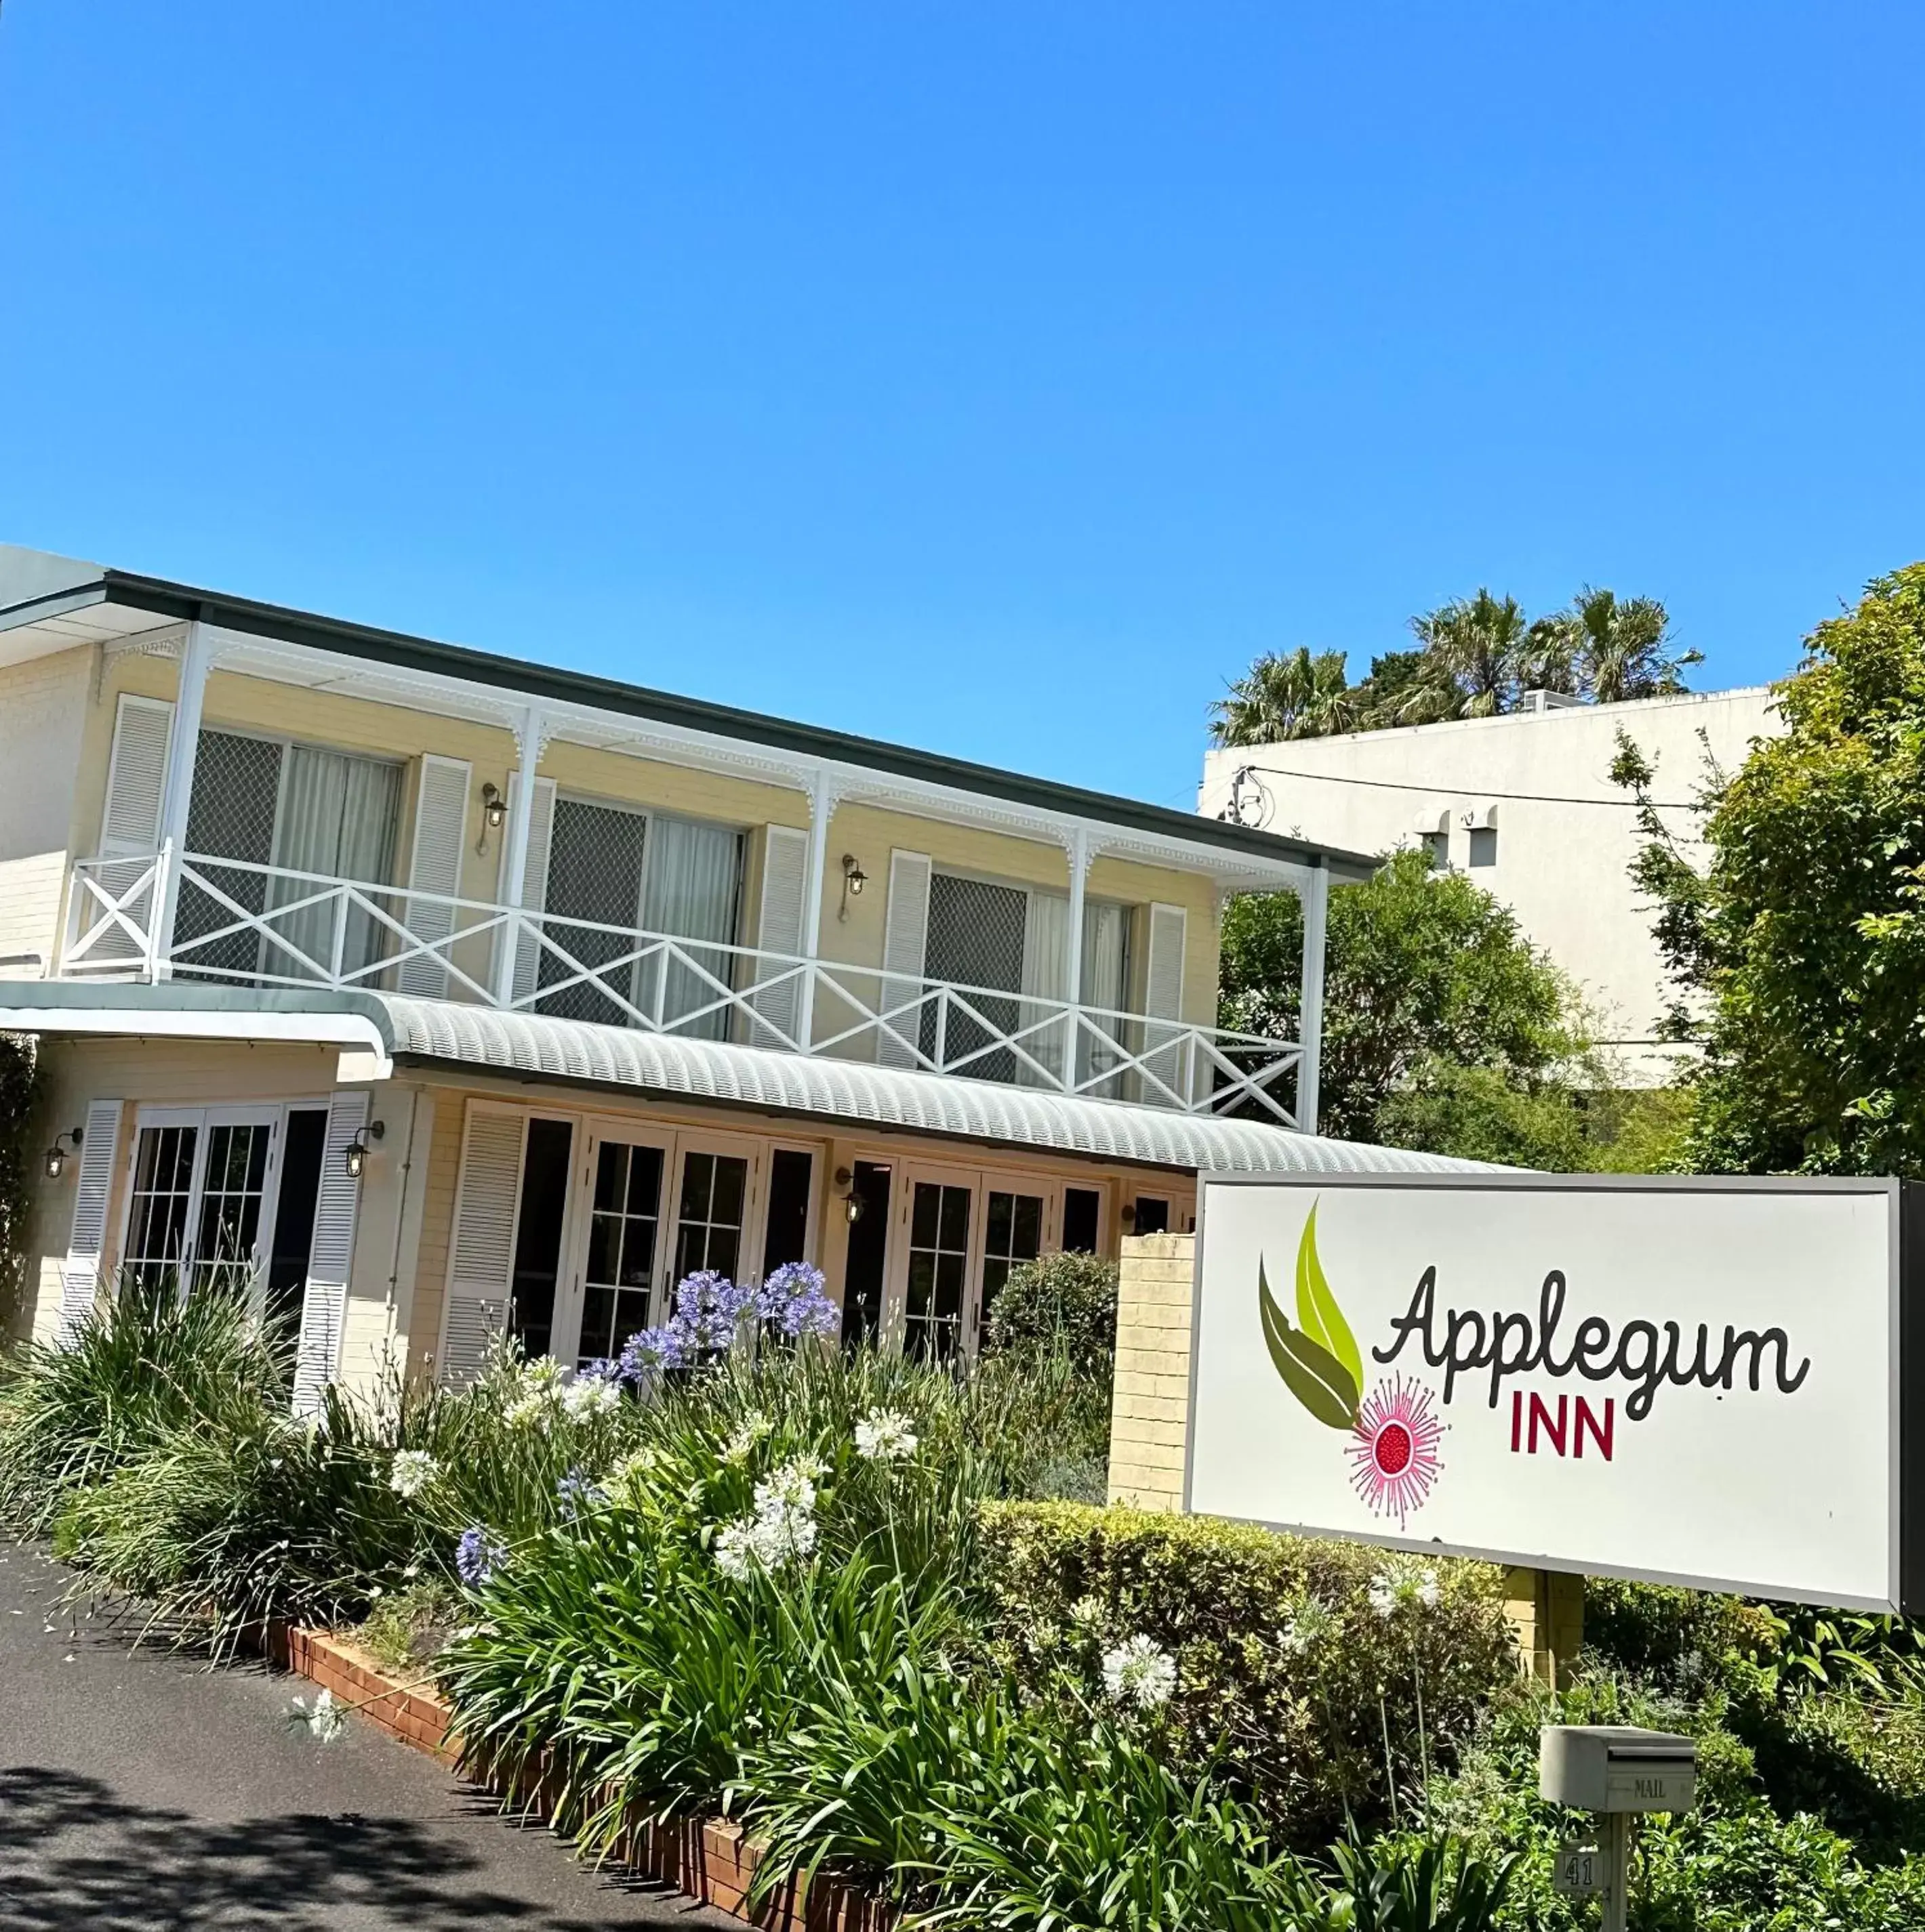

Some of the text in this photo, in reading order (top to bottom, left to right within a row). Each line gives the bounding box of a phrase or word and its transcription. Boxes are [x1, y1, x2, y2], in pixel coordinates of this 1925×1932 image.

[1372, 1265, 1810, 1422] Applegum
[1510, 1390, 1615, 1462] INN
[1634, 1779, 1666, 1799] MAIL
[1564, 1856, 1593, 1886] 41
